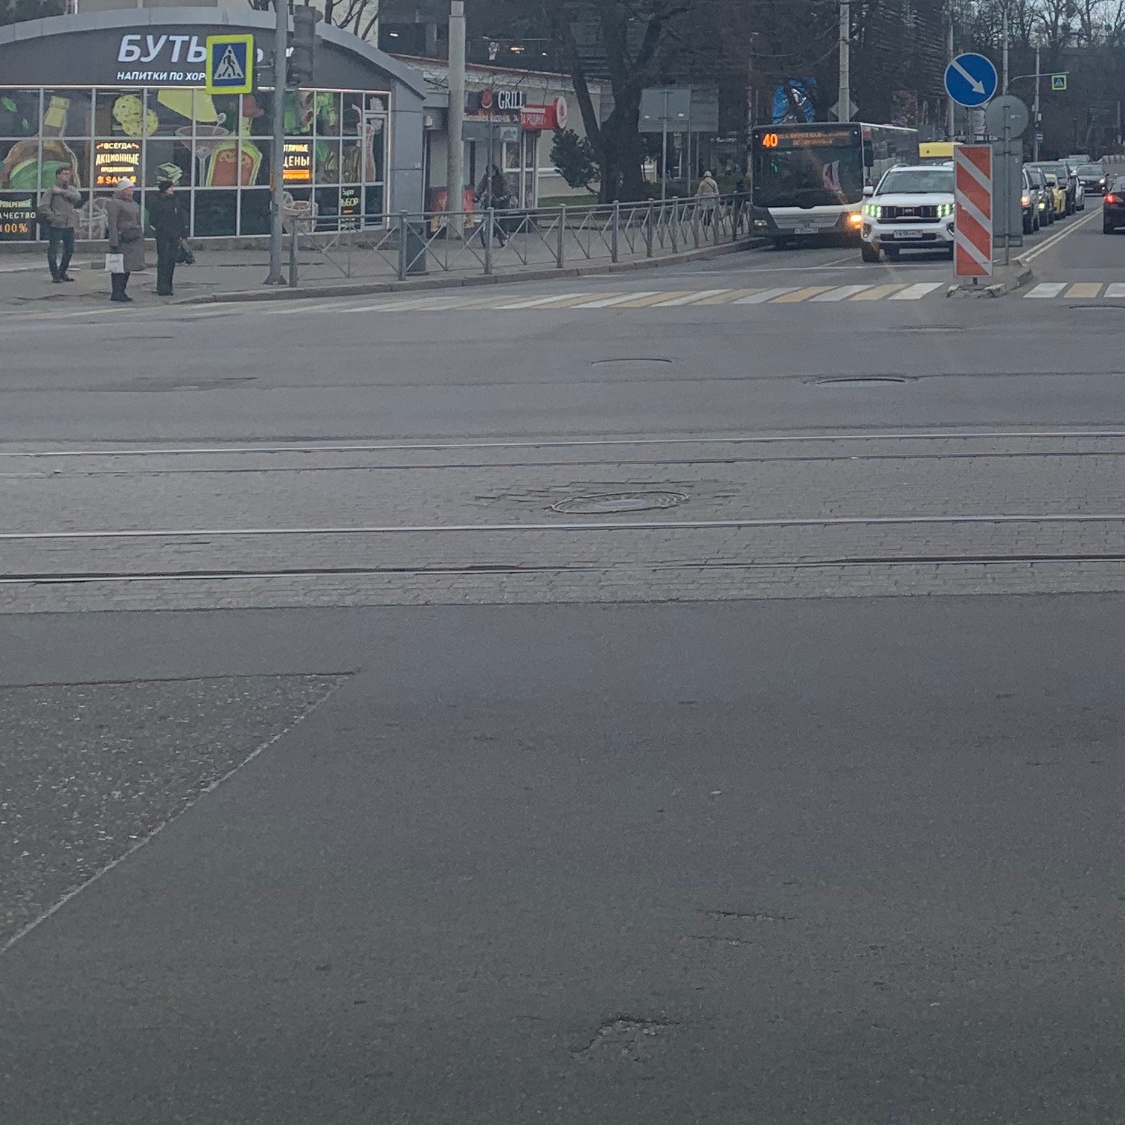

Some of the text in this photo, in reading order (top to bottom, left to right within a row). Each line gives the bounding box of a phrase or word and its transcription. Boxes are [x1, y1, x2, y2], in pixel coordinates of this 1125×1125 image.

[116, 71, 167, 81] НАПИТКИ
[169, 72, 183, 81] ПО
[498, 91, 525, 109] GRILL
[762, 133, 778, 147] 40
[103, 142, 132, 150] ВСЕГДА
[95, 153, 140, 166] АКЦИОННЫЕ
[0, 211, 36, 219] АЧЕСТВО
